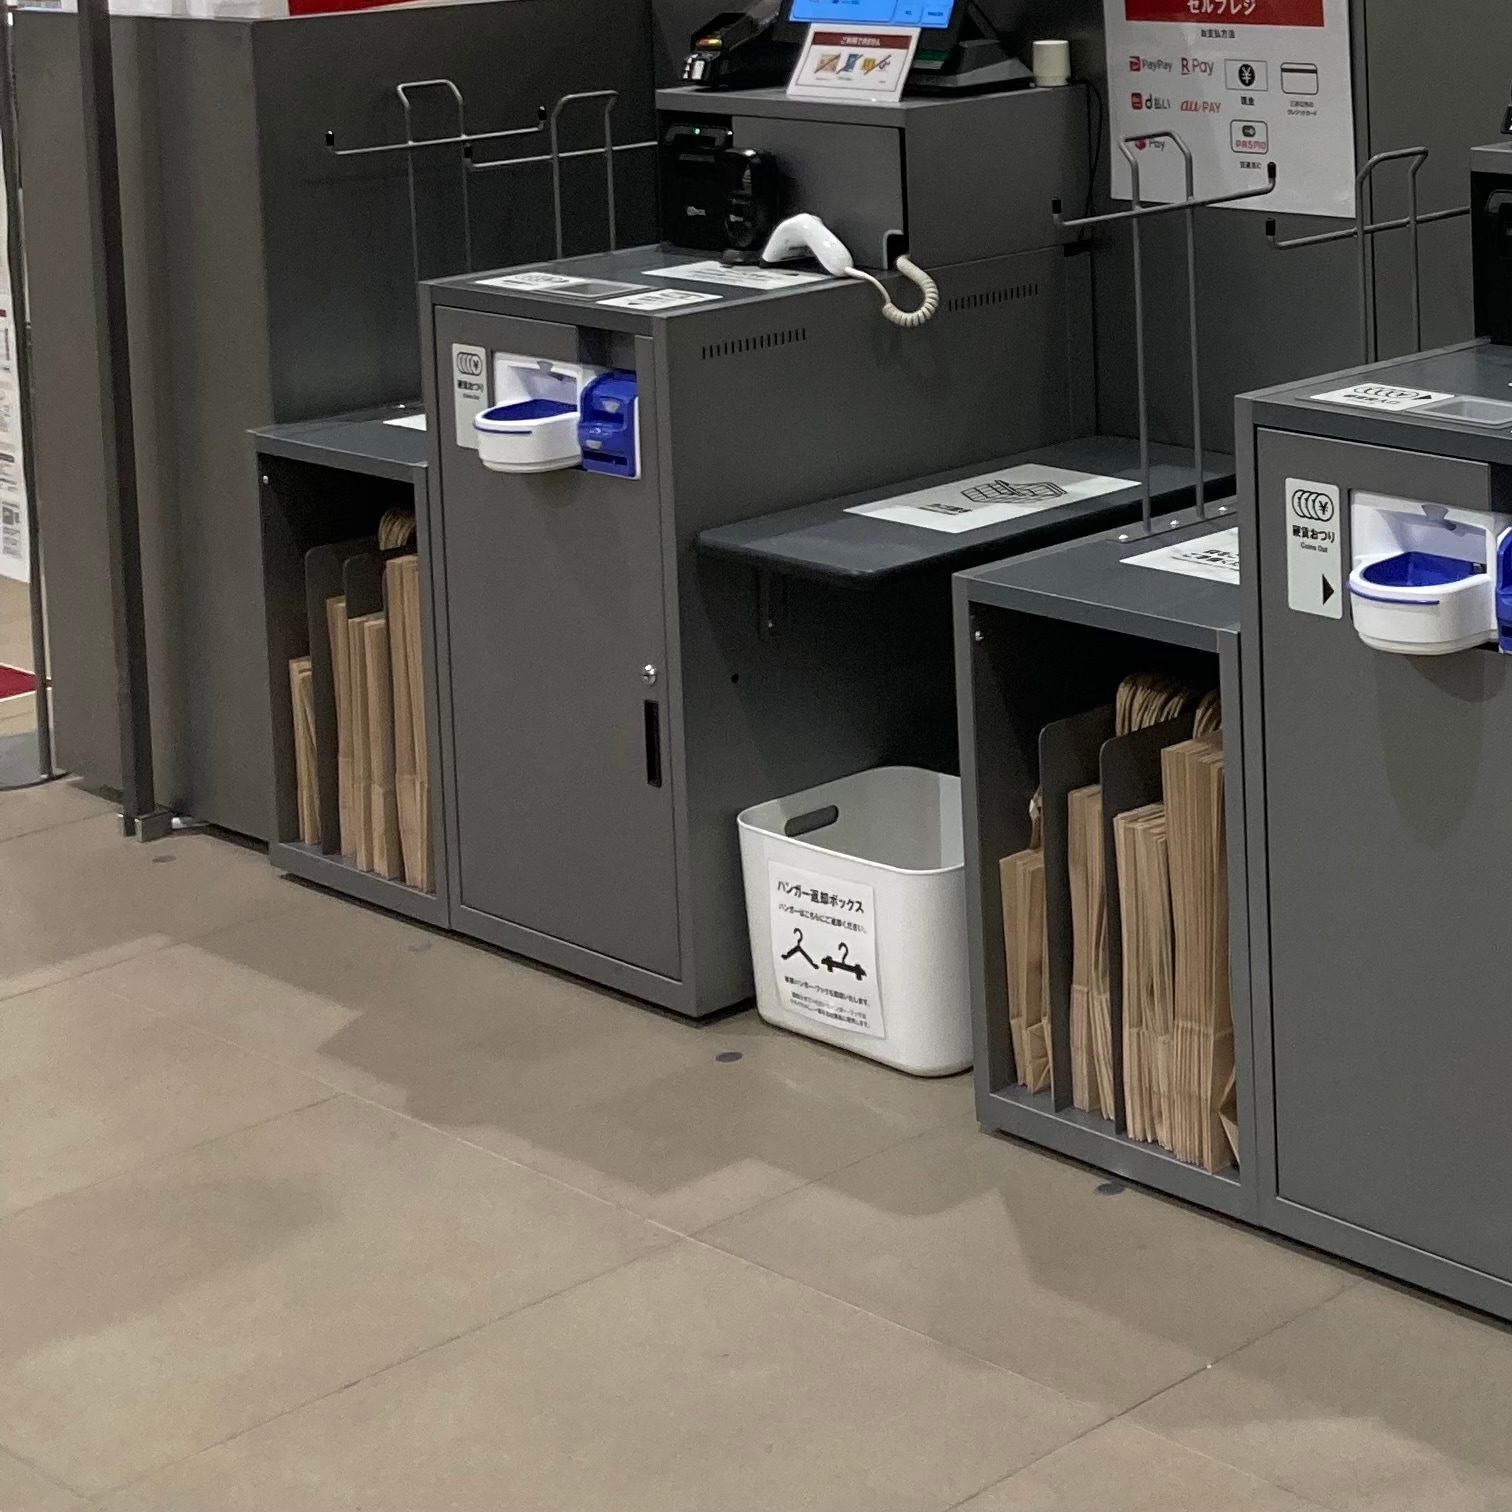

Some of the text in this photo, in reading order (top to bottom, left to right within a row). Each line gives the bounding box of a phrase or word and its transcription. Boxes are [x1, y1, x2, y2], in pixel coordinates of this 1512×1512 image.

[1141, 59, 1173, 73] PayPay
[1192, 58, 1215, 76] Pay
[1201, 101, 1221, 113] PAY
